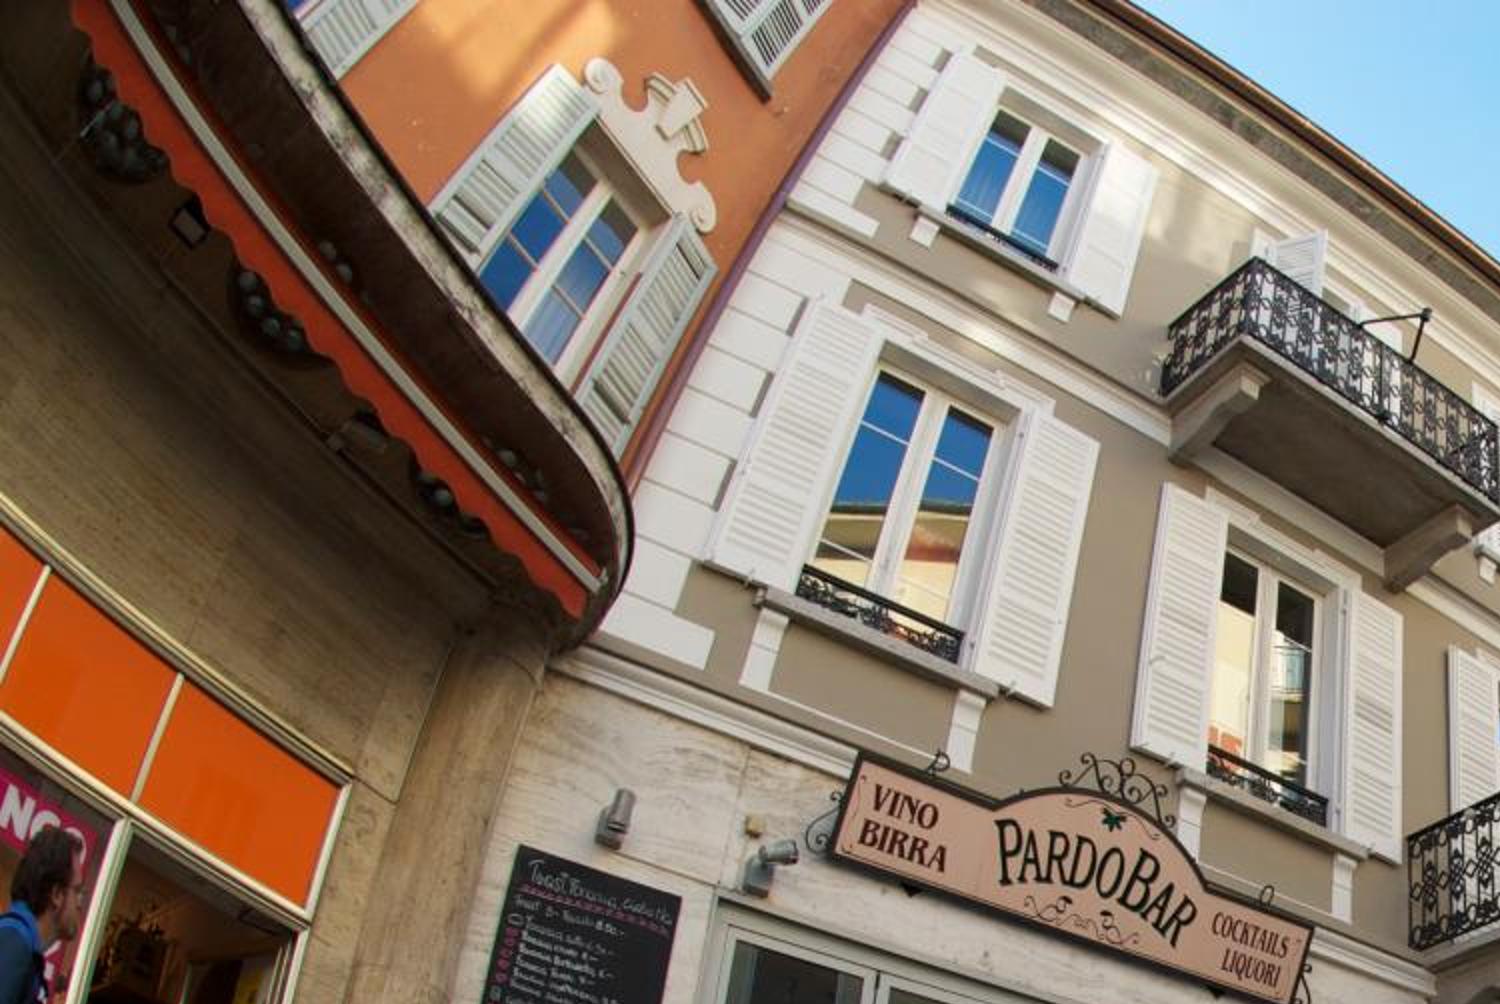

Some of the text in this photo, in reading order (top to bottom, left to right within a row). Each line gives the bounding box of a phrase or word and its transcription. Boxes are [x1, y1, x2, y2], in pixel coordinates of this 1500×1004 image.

[872, 783, 939, 829] VINO
[858, 818, 947, 873] BIRRA
[1210, 911, 1290, 958] COCKTAILS
[1220, 947, 1283, 989] LIQUORI
